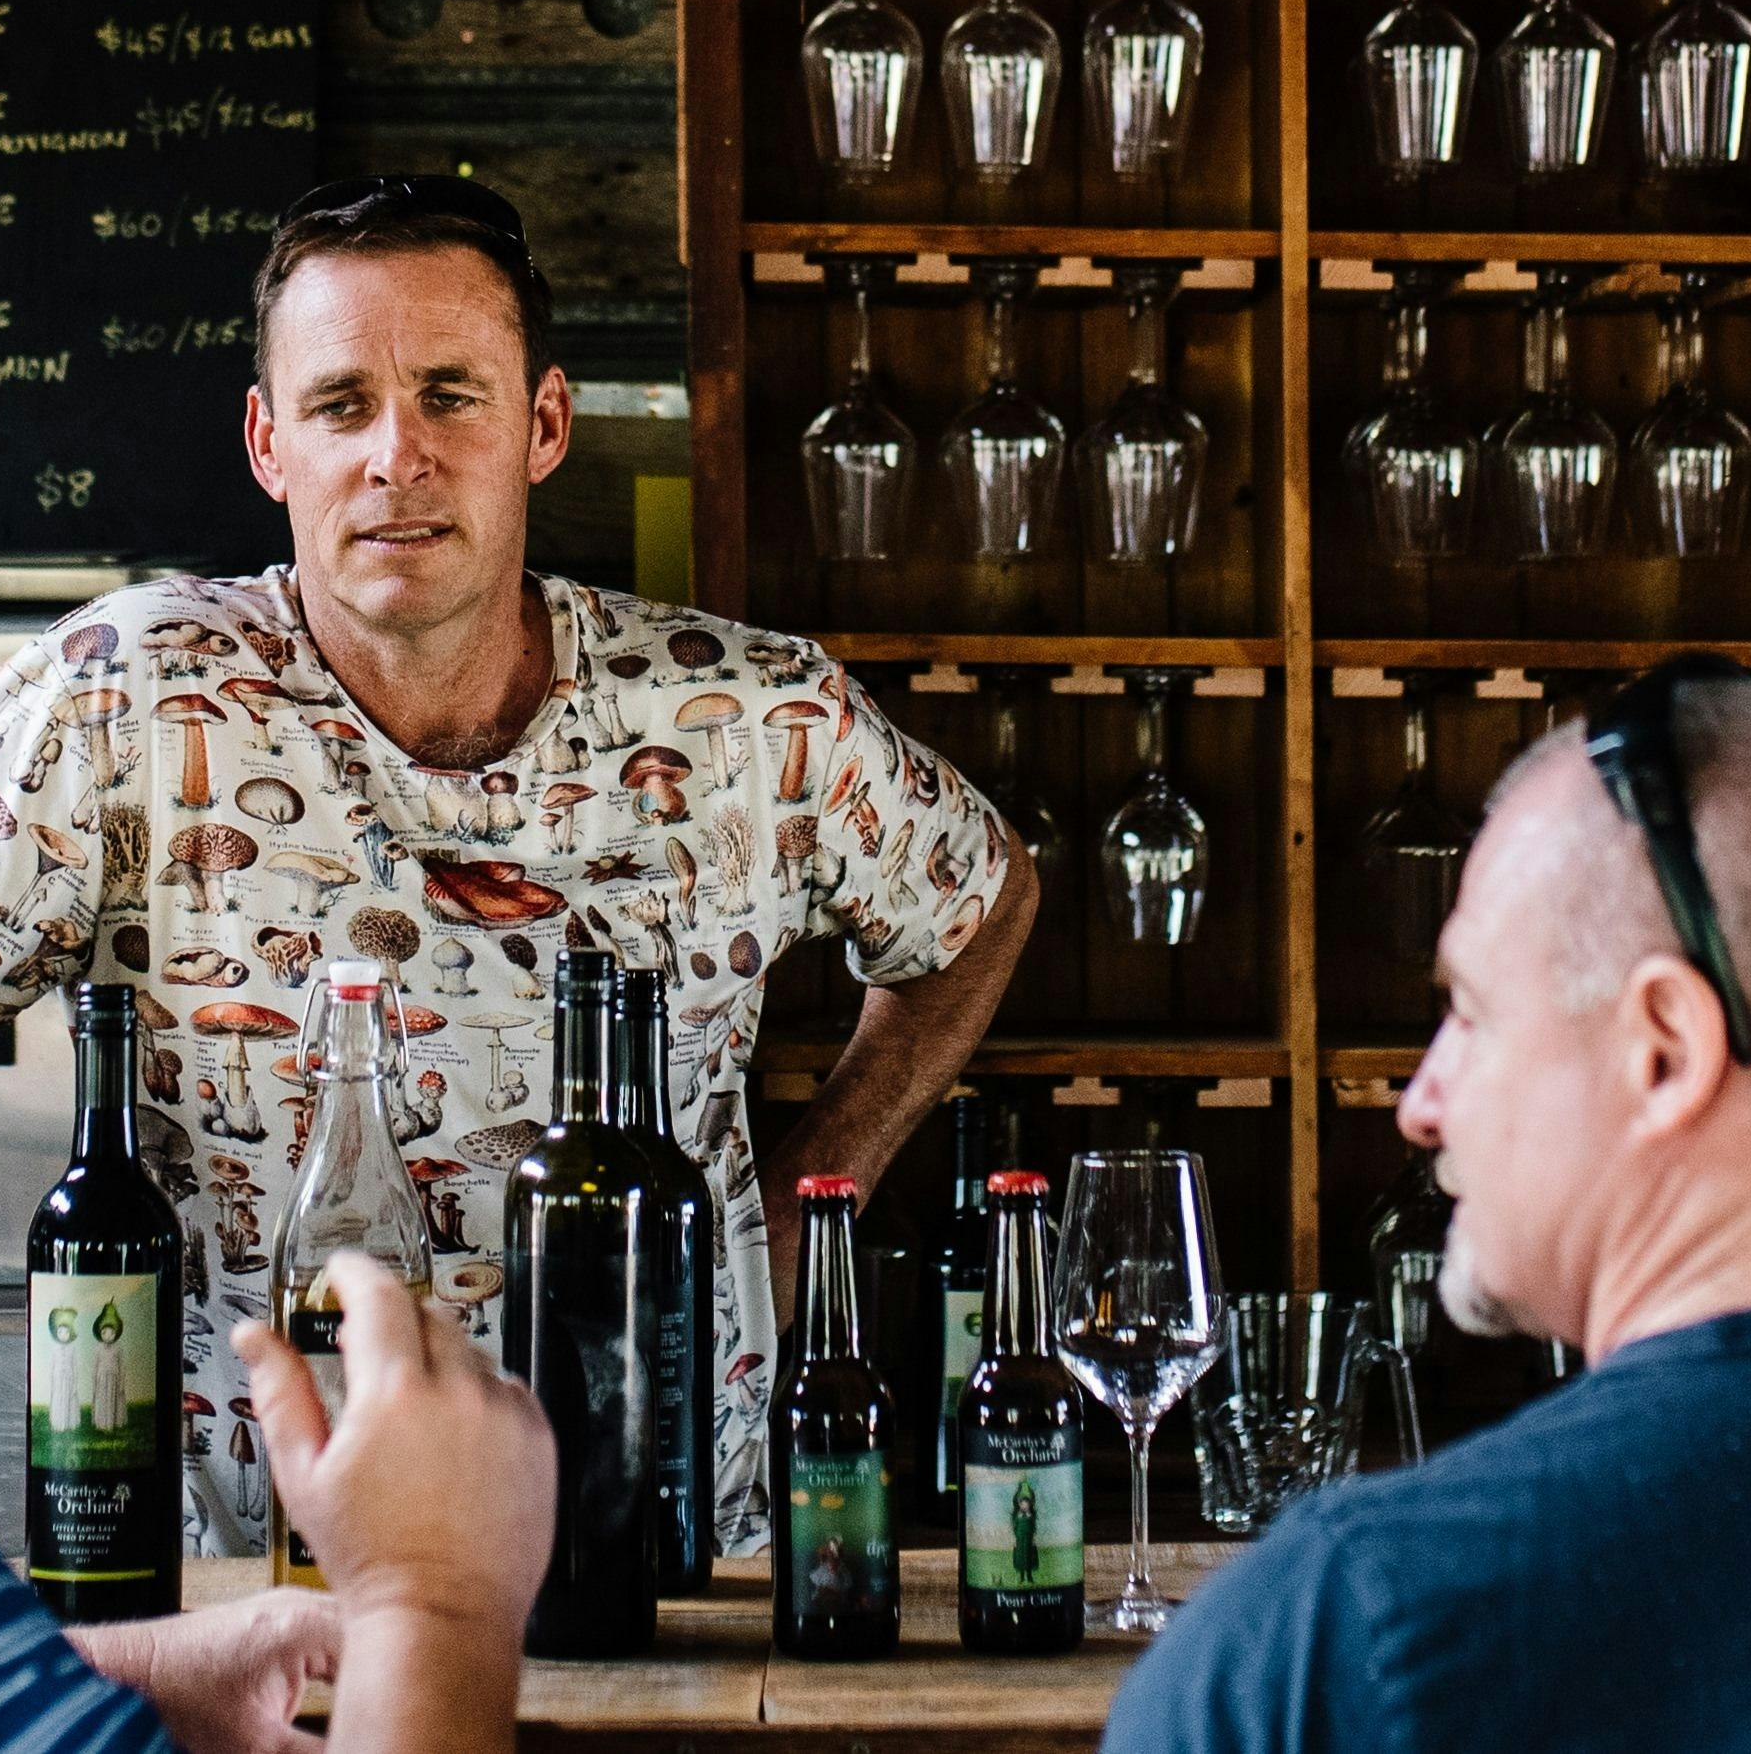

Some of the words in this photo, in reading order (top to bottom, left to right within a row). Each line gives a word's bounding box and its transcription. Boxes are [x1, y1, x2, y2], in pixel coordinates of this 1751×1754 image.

[34, 462, 96, 514] $8
[1002, 1446, 1062, 1464] Orchard
[808, 1473, 865, 1486] Orchard
[44, 1481, 108, 1499] McCarthy's
[57, 1496, 124, 1515] Orchard
[997, 1592, 1026, 1608] Pear
[1030, 1593, 1063, 1607] Cider
